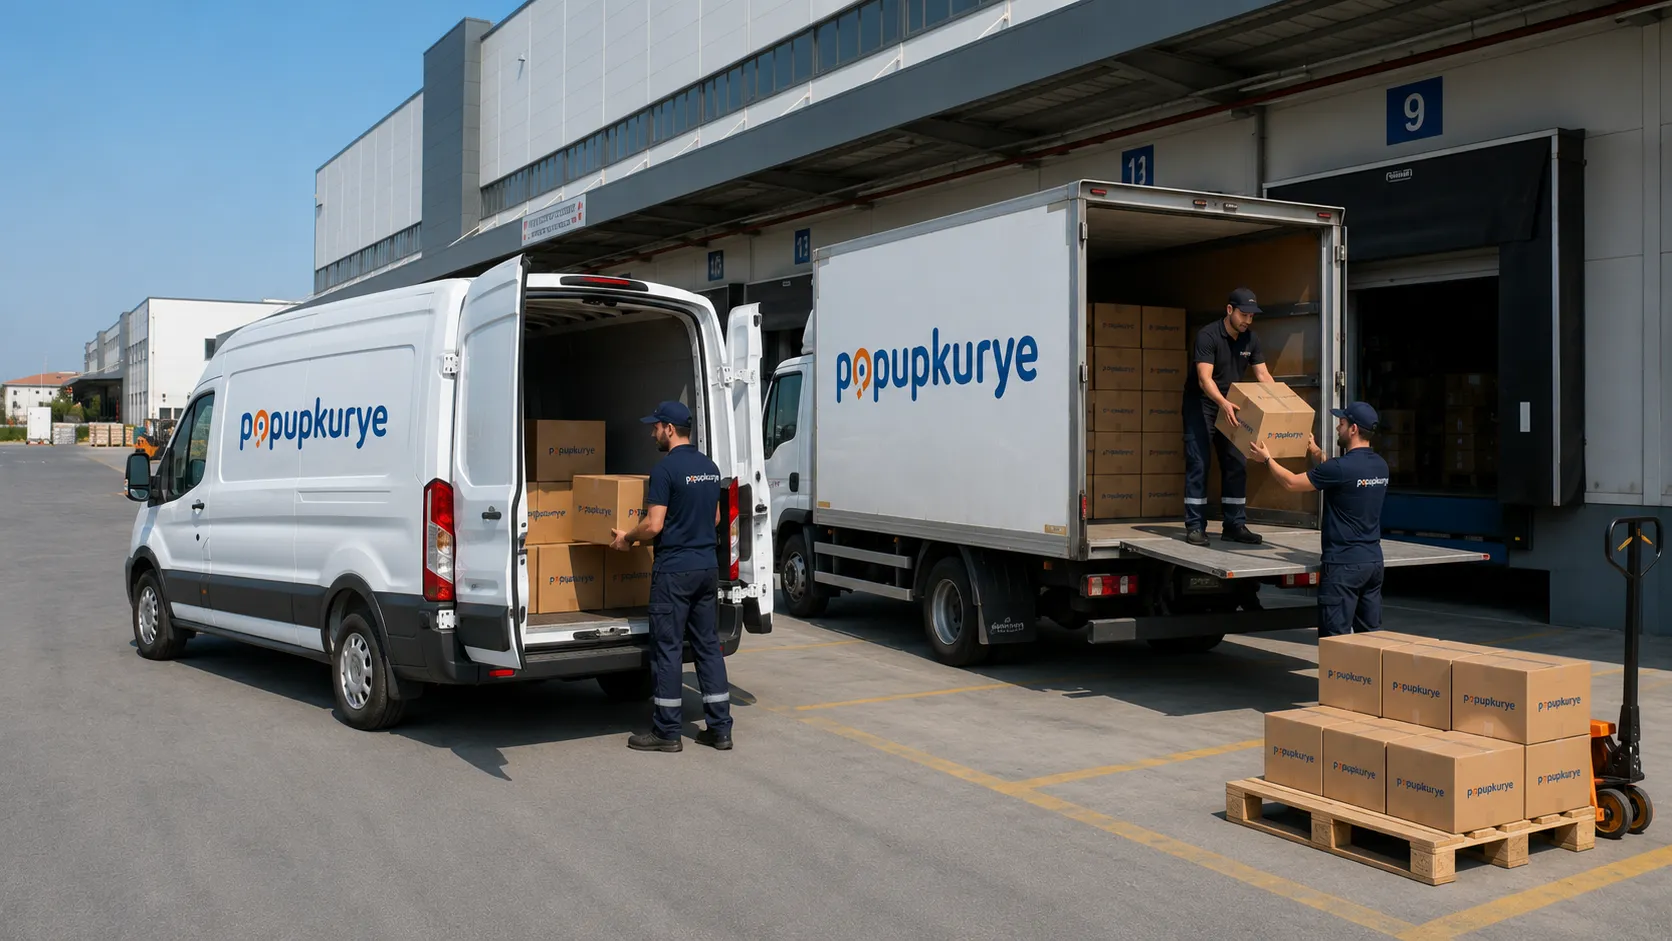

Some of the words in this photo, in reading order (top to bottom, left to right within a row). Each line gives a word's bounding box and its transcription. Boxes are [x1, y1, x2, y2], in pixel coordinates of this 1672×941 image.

[1403, 92, 1425, 132] 9
[1128, 155, 1147, 186] 13
[836, 327, 1038, 404] popupkurye
[239, 397, 388, 451] popupkurye
[1328, 668, 1372, 686] popupkurye
[1392, 680, 1441, 699] popupkurye
[1463, 693, 1516, 712] popupkurye
[1538, 695, 1582, 712] popupkurye
[1273, 745, 1315, 764] popupkurye
[1333, 760, 1376, 780] popupkurye
[1537, 768, 1581, 785] popupkurye
[1396, 776, 1444, 798] popupkurye
[1467, 779, 1514, 799] popupkurye
